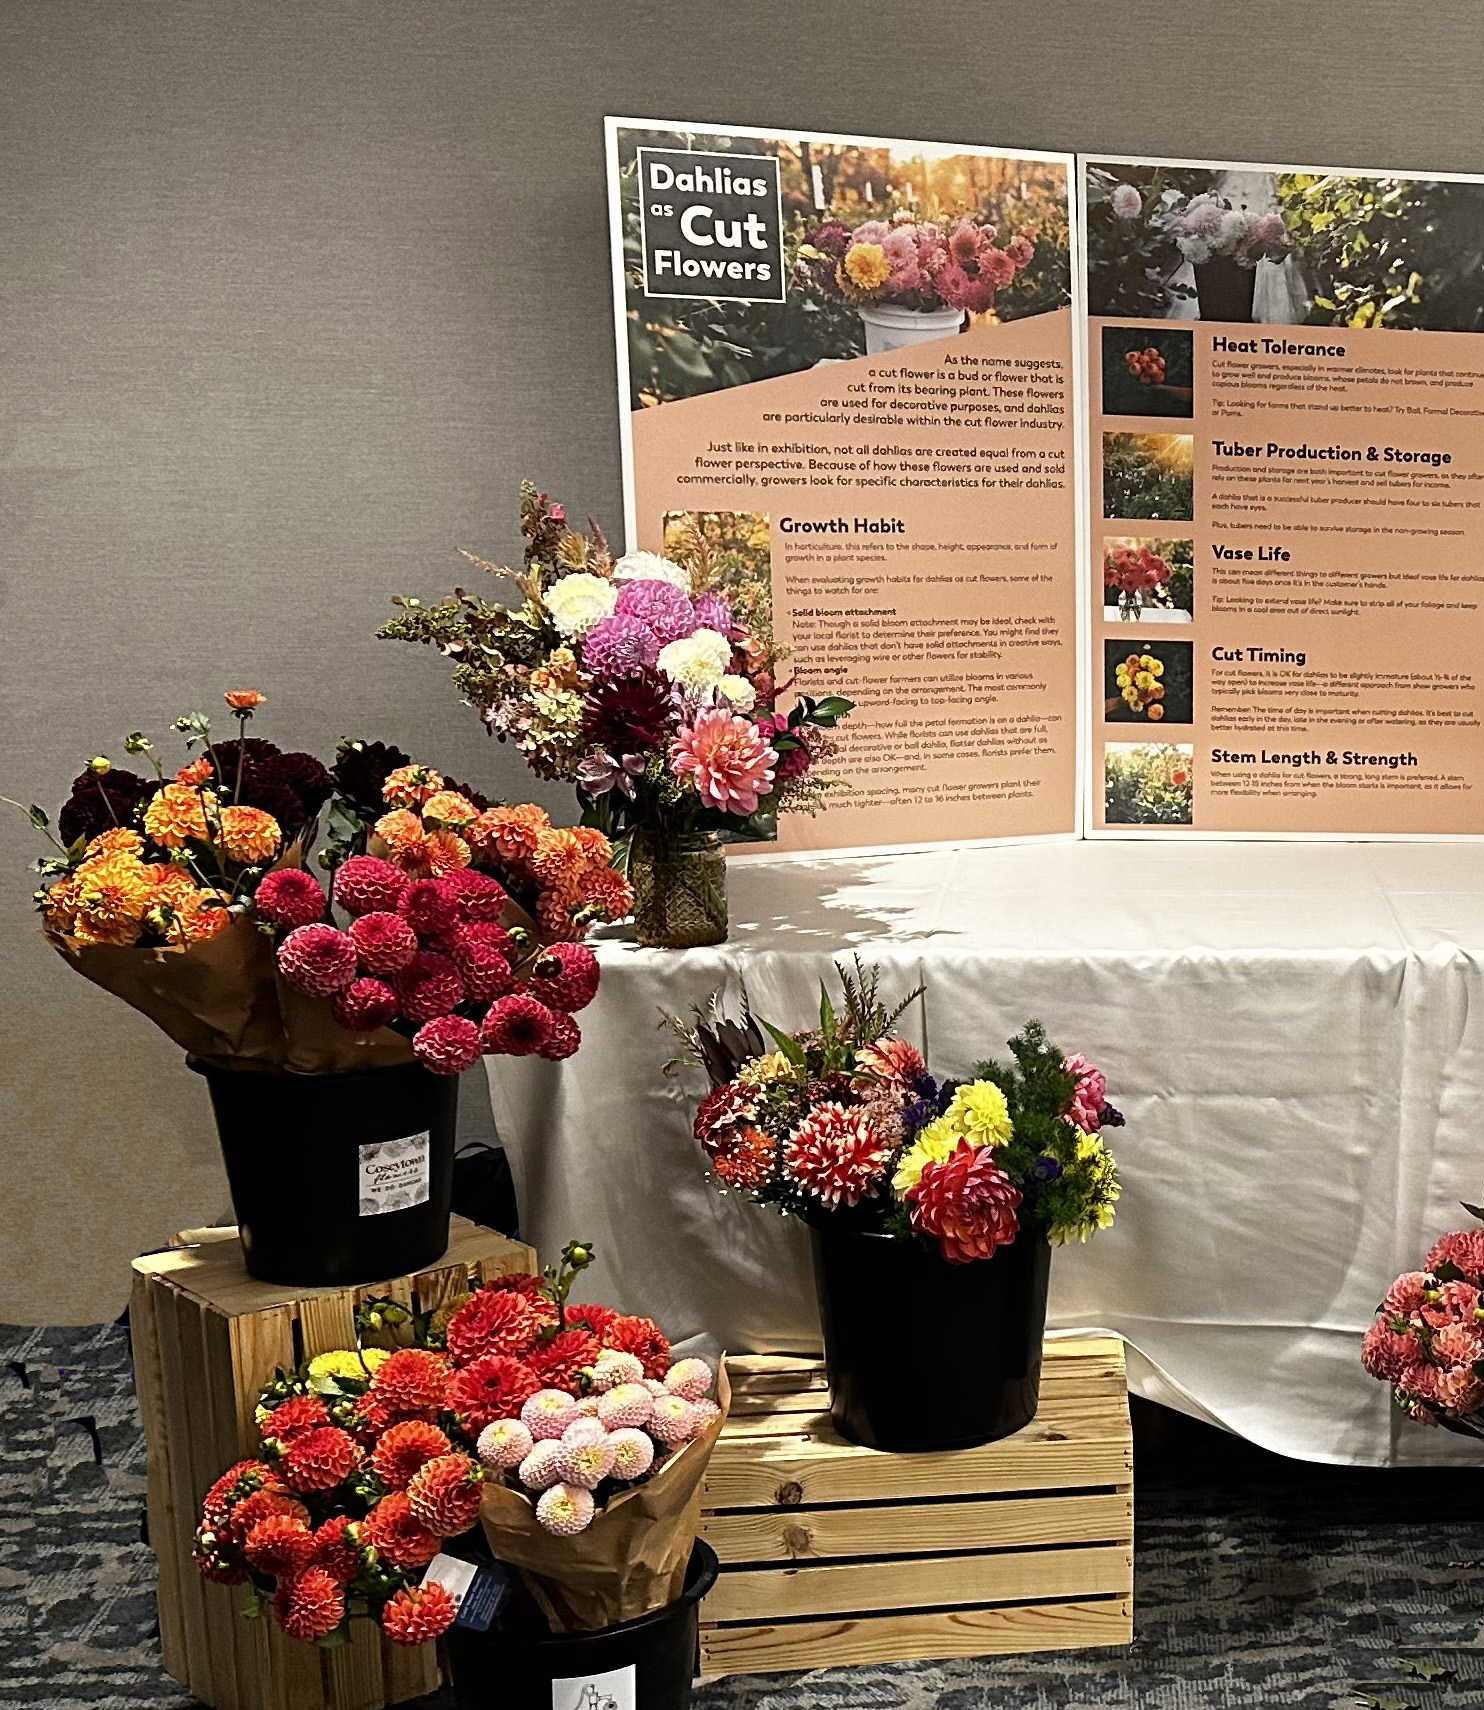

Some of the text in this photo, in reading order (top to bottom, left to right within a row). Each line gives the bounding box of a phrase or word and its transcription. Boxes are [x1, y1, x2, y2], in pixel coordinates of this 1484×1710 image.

[649, 163, 768, 197] Dahlias
[651, 204, 768, 249] as Cut
[654, 250, 771, 281] Flowers
[1212, 337, 1346, 357] Heat Tolerance
[944, 352, 958, 364] As
[960, 353, 978, 365] the
[981, 357, 1011, 366] name
[868, 366, 1064, 384] a cut flower is a bud or flower that is
[847, 381, 865, 393] cut
[868, 382, 895, 394] from
[897, 383, 911, 395] its
[914, 383, 956, 399] bearing
[993, 385, 1023, 398] These
[1026, 386, 1064, 399] flowers
[820, 399, 838, 408] are
[841, 397, 868, 409] used
[871, 397, 886, 409] for
[889, 398, 947, 411] decorative
[1003, 401, 1024, 413] and
[1026, 402, 1064, 414] dahlias
[762, 413, 781, 422] are
[784, 411, 850, 427] particularly
[853, 412, 903, 425] desirable
[906, 414, 941, 426] within
[943, 415, 961, 427] the
[964, 415, 982, 427] cut
[984, 416, 1017, 428] flower
[708, 441, 732, 453] Just
[734, 441, 754, 453] like
[757, 442, 768, 454] in
[833, 443, 853, 455] not
[855, 444, 869, 455] all
[872, 444, 912, 456] dahlias
[914, 448, 932, 456] are
[935, 445, 977, 457] created
[979, 446, 1009, 461] equal
[1011, 446, 1036, 458] from
[1038, 450, 1045, 458] a
[1047, 447, 1064, 459] cut
[1212, 441, 1451, 467] Tuber Production & Storage
[695, 457, 731, 469] flower
[808, 458, 856, 470] Because
[858, 459, 870, 470] of
[872, 459, 896, 471] how
[899, 459, 930, 471] these
[932, 460, 971, 472] flowers
[974, 463, 991, 472] are
[994, 461, 1019, 473] used
[1021, 461, 1042, 473] and
[1044, 461, 1065, 473] sold
[760, 476, 807, 489] growers
[809, 474, 833, 486] look
[836, 474, 852, 486] for
[855, 474, 896, 490] specific
[899, 475, 979, 487] characteristics
[981, 476, 995, 488] for
[998, 476, 1023, 488] their
[779, 516, 905, 533] Growth Habit
[1212, 545, 1290, 561] Vase Life
[1212, 646, 1306, 667] Cut Timing
[1211, 749, 1418, 769] Stem Length & Strength
